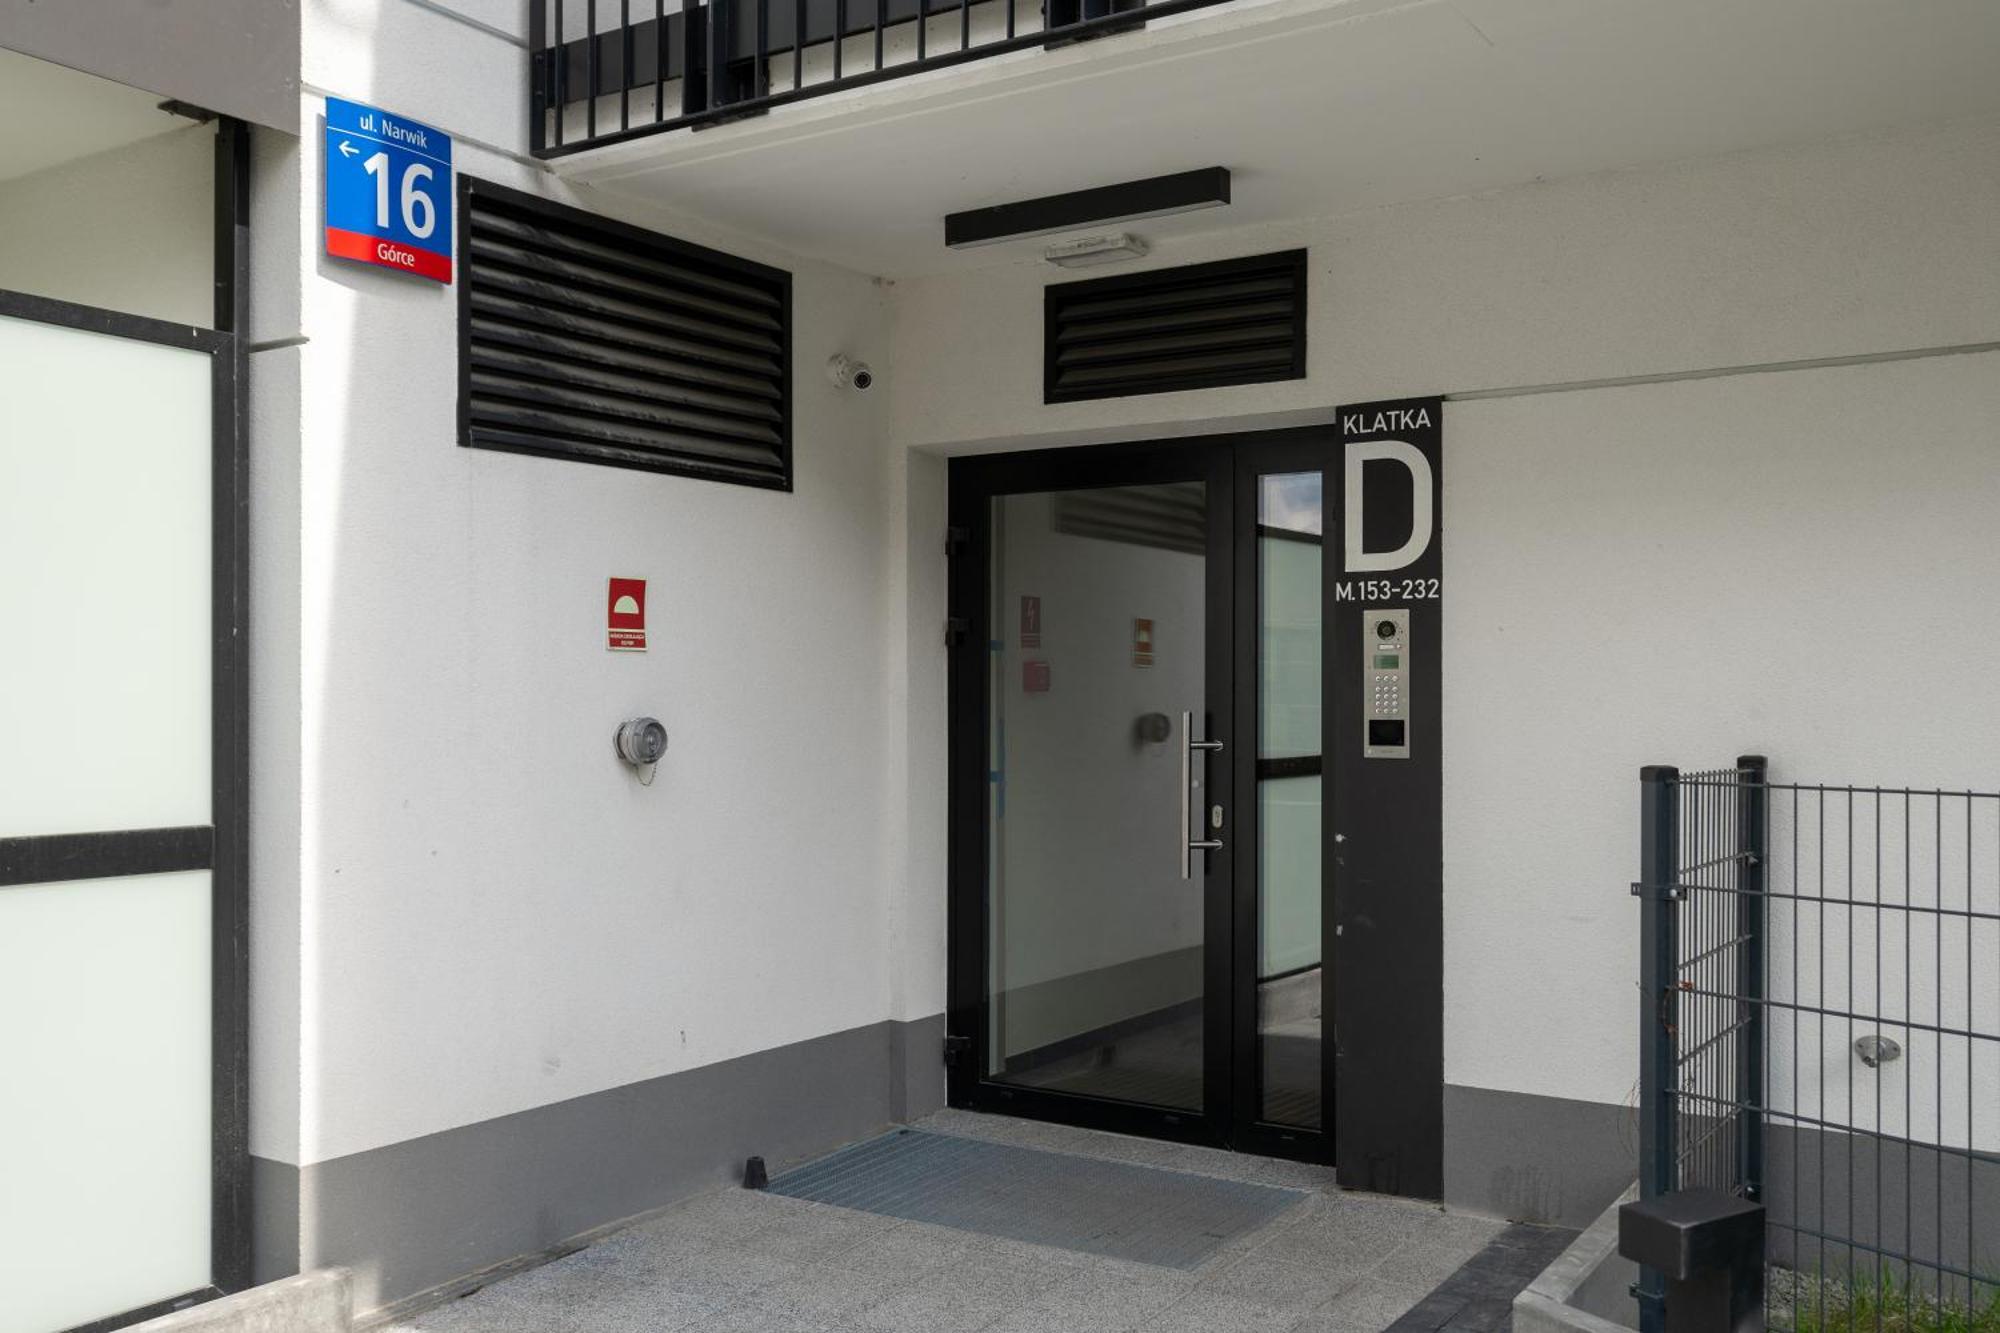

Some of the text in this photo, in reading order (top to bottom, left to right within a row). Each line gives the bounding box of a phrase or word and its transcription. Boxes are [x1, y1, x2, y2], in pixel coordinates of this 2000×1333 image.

[359, 114, 428, 149] ul. Narwik
[363, 151, 436, 239] 16
[377, 243, 415, 267] Górce
[1343, 407, 1432, 435] KLATKA
[1344, 440, 1433, 573] D
